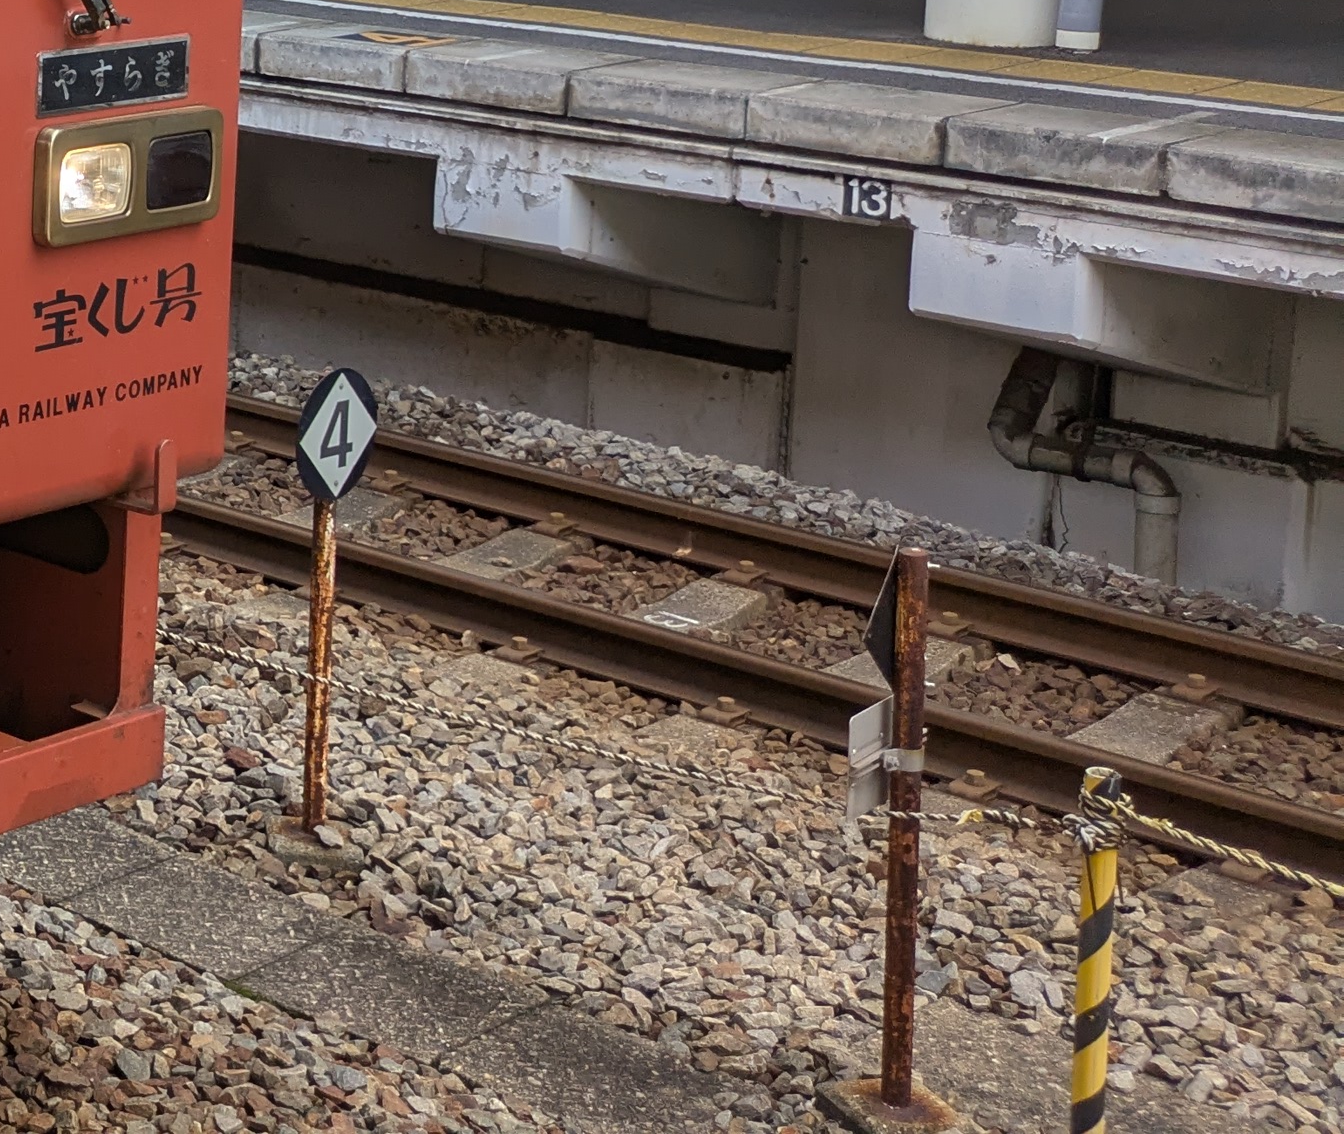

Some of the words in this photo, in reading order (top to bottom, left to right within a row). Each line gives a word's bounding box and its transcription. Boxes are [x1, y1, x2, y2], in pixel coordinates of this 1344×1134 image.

[51, 50, 175, 96] やすらぎ
[848, 178, 888, 216] 13
[33, 263, 202, 352] 宝くじ号
[18, 386, 107, 425] RAILWAY
[115, 365, 204, 403] COMPANY
[320, 399, 353, 468] 4
